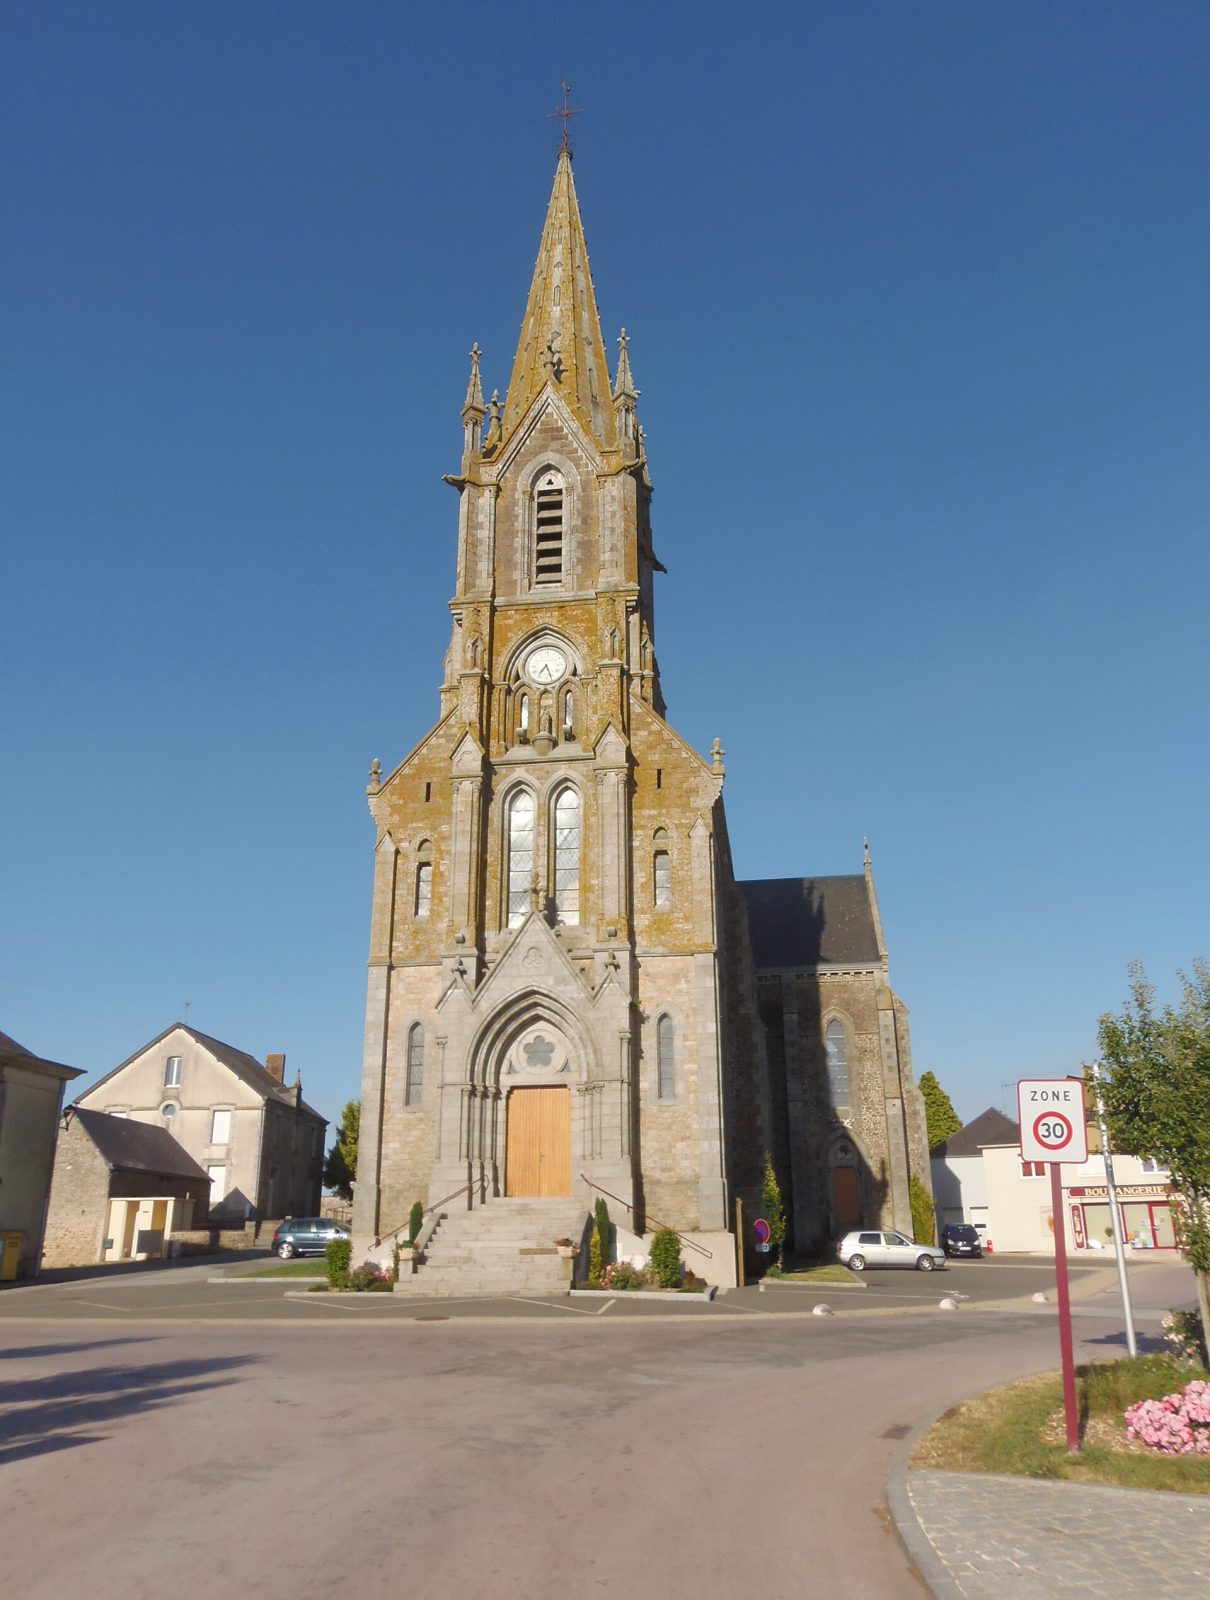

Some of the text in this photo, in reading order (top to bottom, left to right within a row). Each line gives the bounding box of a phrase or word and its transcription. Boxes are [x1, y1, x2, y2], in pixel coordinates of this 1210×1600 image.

[1030, 1090, 1071, 1101] ZONE
[1041, 1122, 1064, 1138] 30
[1084, 1186, 1165, 1196] BOUANGERIE
